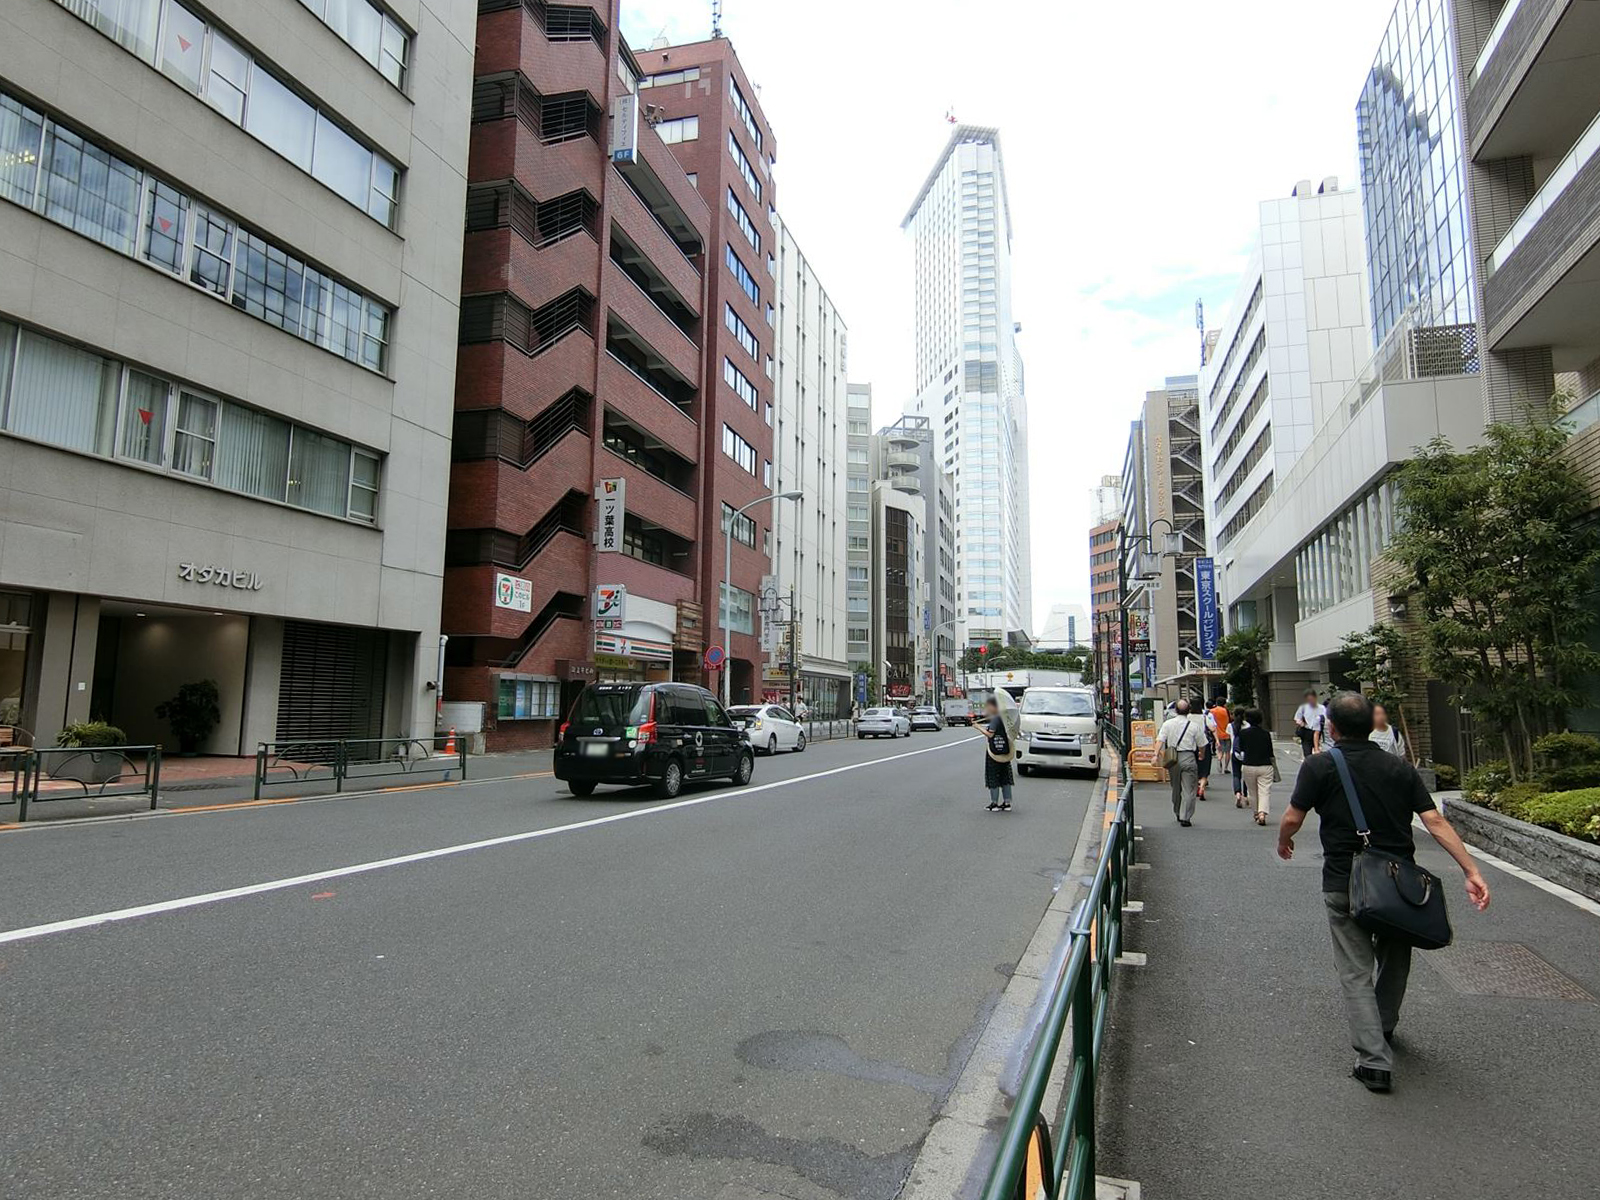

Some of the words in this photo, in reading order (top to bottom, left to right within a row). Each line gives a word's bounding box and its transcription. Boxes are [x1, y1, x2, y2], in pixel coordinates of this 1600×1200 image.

[616, 151, 630, 159] 6F
[603, 498, 616, 548] 一ツ葉高校
[178, 562, 263, 591] オダカビル
